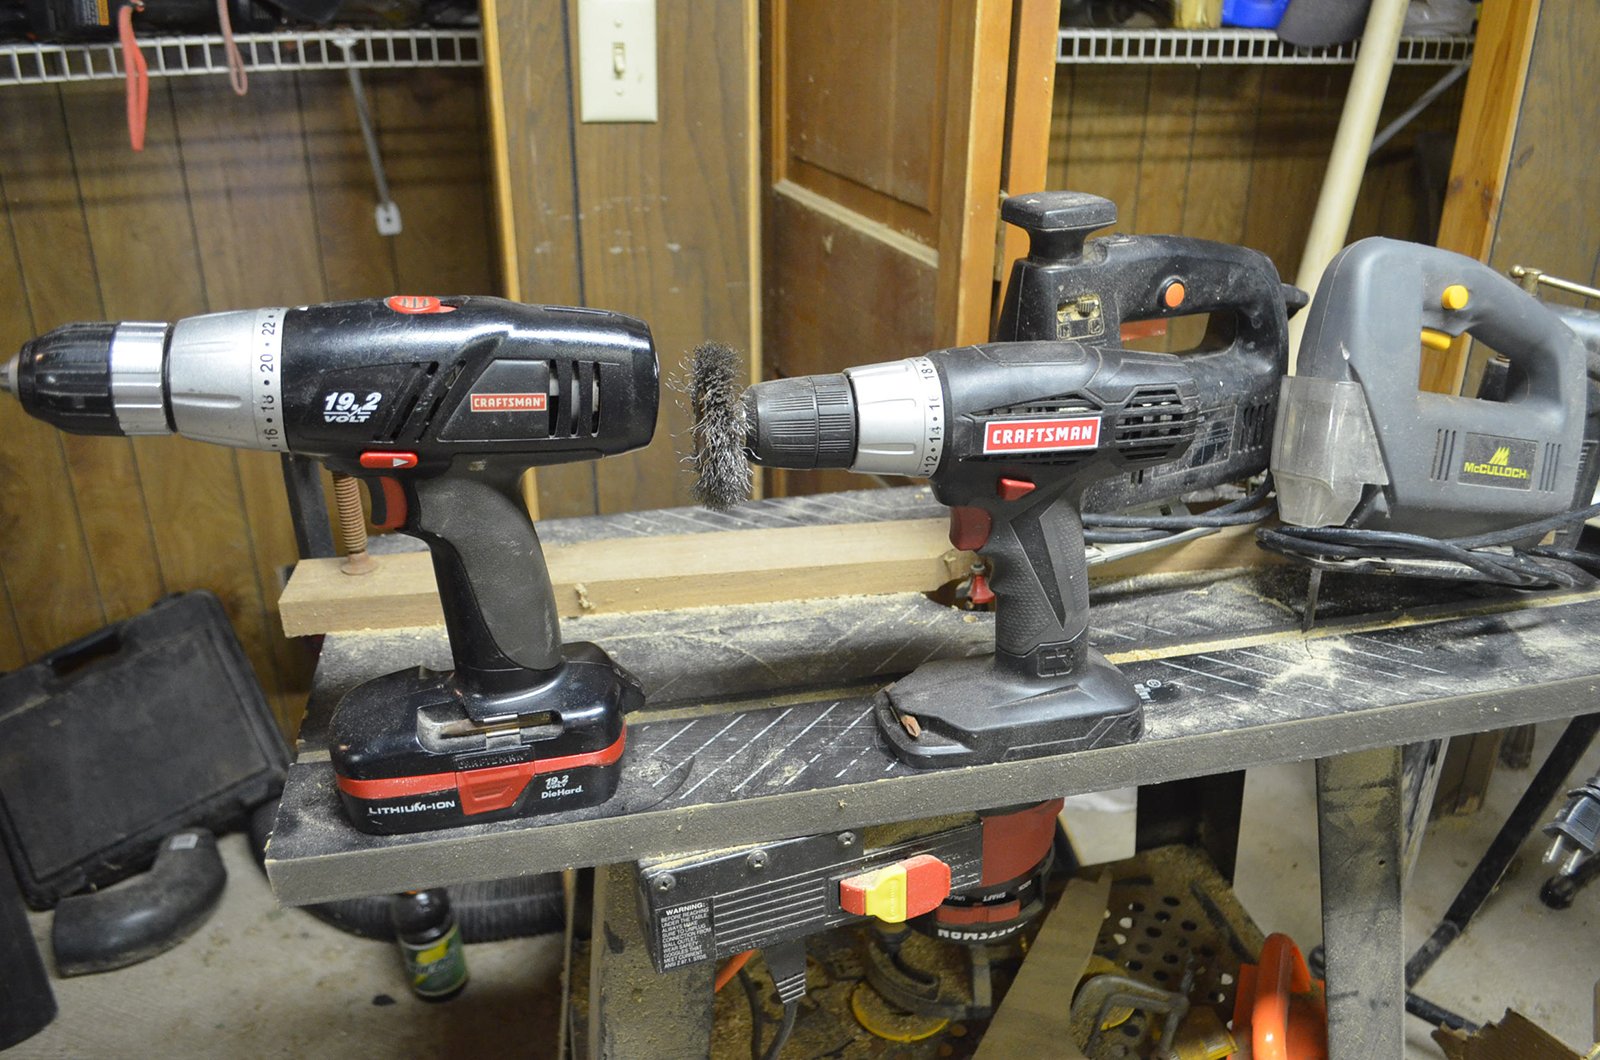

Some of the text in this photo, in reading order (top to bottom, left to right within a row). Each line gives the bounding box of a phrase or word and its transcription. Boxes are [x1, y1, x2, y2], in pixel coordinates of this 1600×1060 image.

[261, 321, 276, 335] 22
[260, 353, 274, 372] 20
[324, 391, 382, 411] 19.2
[474, 397, 542, 408] CRAFTSMAN
[324, 415, 370, 423] VOLT
[264, 428, 279, 441] 16
[992, 425, 1094, 445] CRAFTSMAN
[926, 455, 938, 470] 12
[1463, 461, 1528, 479] McCULLOCH
[541, 785, 583, 799] DieHard
[368, 800, 456, 815] LITHIUM-ION
